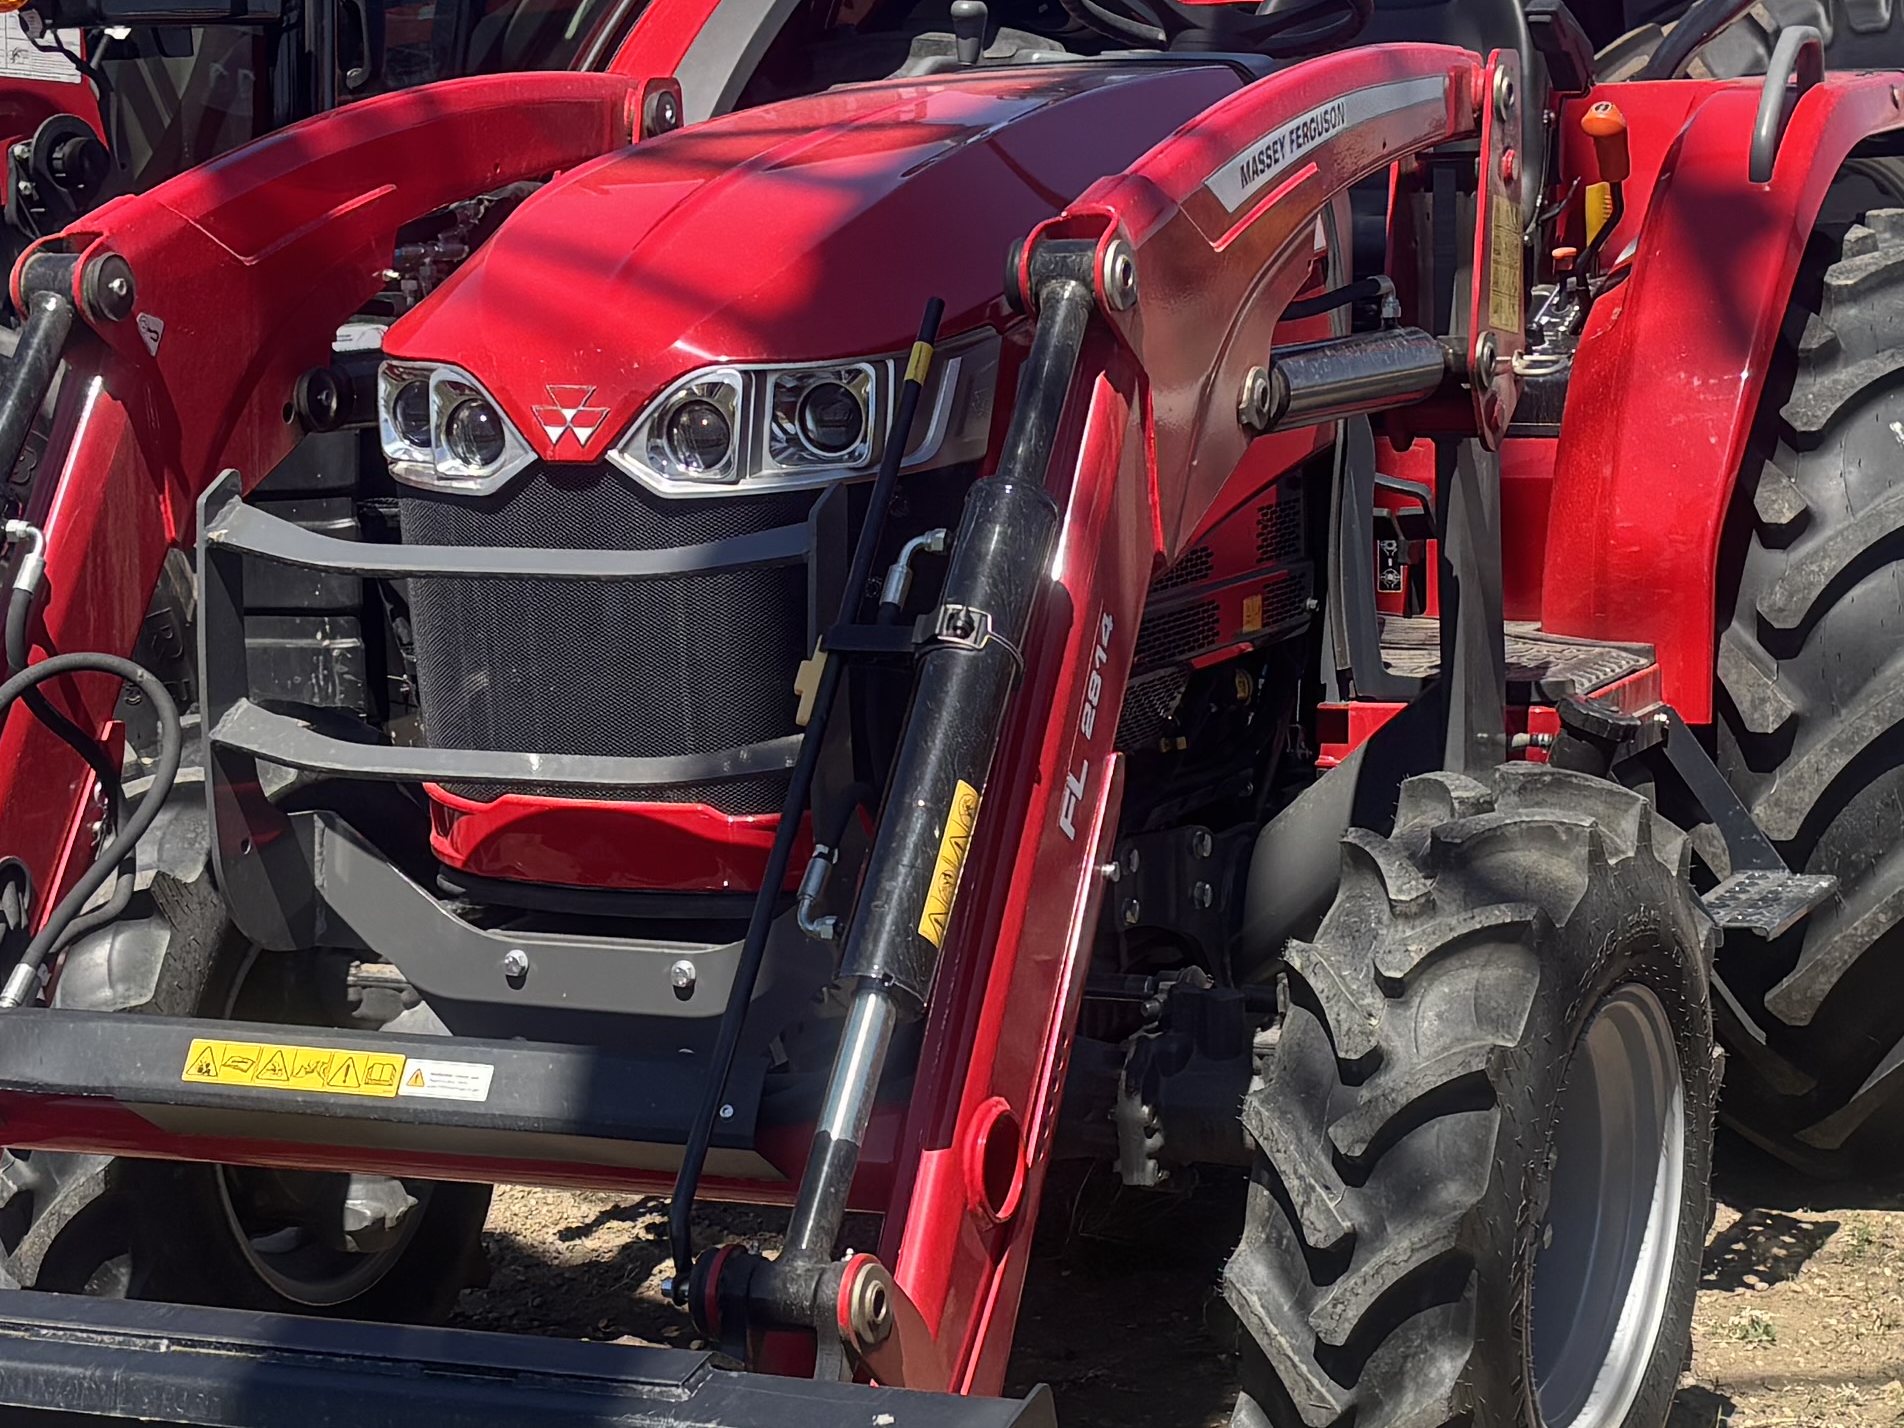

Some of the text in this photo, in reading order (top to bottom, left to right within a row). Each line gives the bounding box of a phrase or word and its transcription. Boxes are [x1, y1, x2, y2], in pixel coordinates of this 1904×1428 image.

[1240, 102, 1345, 190] MASSEY FERGUSON
[1059, 613, 1114, 840] FL 2814
